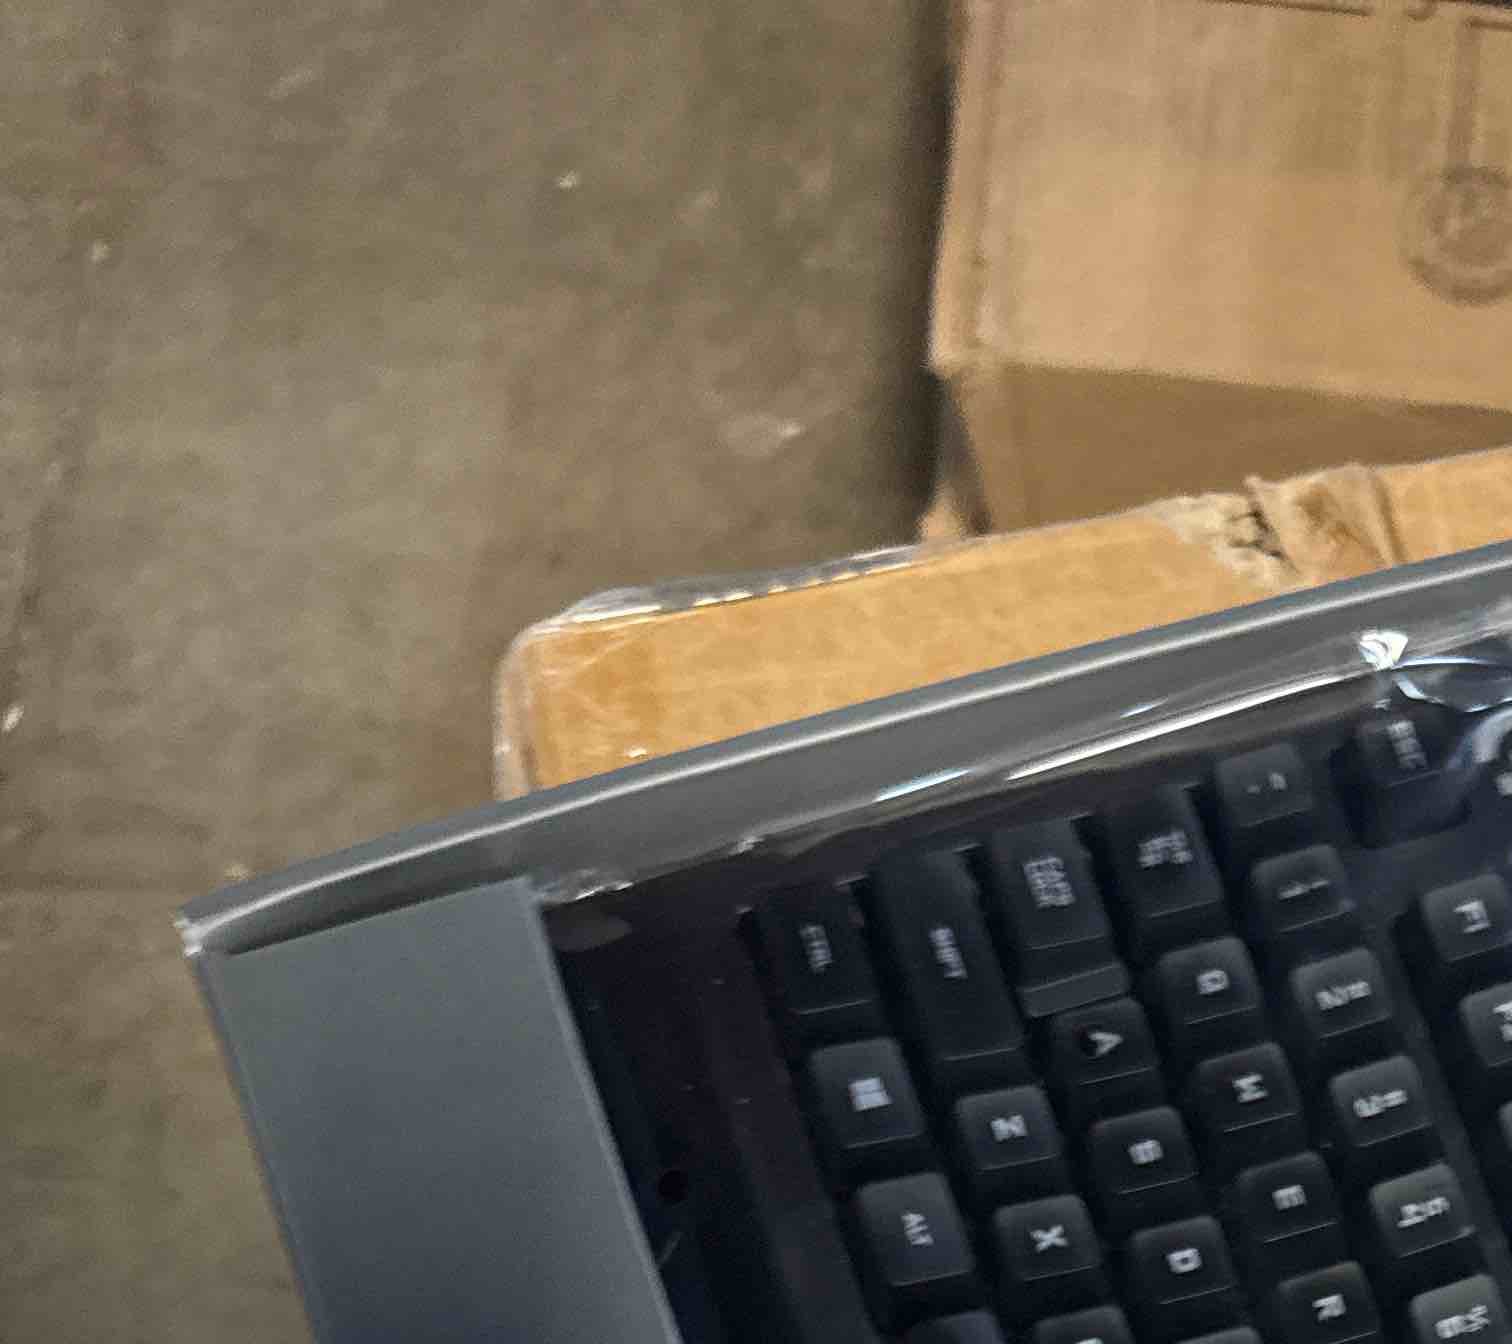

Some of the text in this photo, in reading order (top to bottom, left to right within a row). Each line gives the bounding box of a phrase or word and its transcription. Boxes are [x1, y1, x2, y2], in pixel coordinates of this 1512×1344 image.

[1453, 899, 1489, 933] F1
[1233, 1074, 1266, 1102] W
[1030, 1225, 1067, 1251] X
[1167, 1247, 1201, 1273] D
[1313, 1294, 1345, 1321] R
